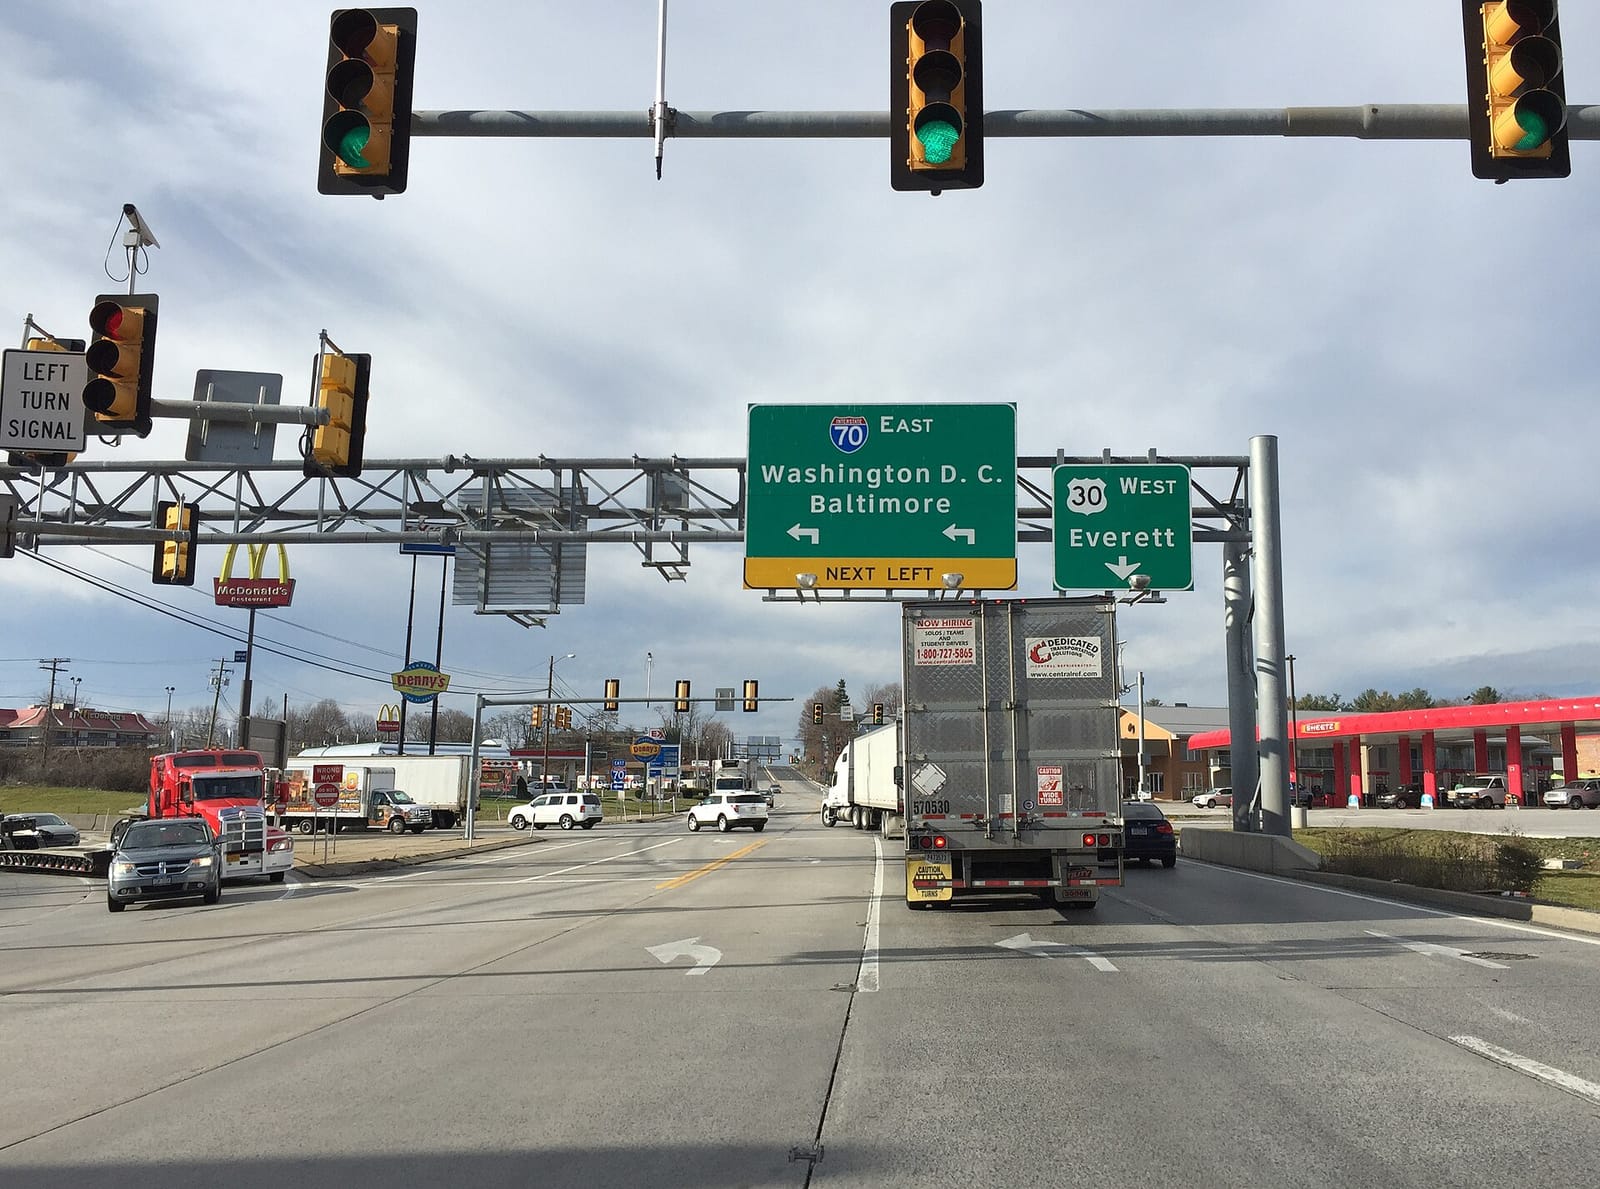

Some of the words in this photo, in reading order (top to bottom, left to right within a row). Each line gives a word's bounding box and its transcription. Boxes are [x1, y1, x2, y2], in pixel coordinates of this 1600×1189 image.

[24, 363, 69, 382] LEFT
[21, 391, 69, 411] TURN
[8, 419, 76, 440] SIGNAL
[834, 425, 863, 446] 70
[761, 463, 930, 488] Washington
[941, 465, 966, 483] D.
[978, 465, 1002, 483] C.
[810, 493, 951, 513] Baltimore
[1071, 486, 1102, 506] 30
[1070, 528, 1175, 547] Everett
[826, 567, 875, 581] NEXT
[887, 567, 933, 581] LEFT
[217, 586, 288, 596] McDonald's
[1047, 638, 1099, 653] DEDICATED
[1050, 646, 1095, 658] TRANSPORTATION
[917, 648, 973, 659] 1-800-727-5865
[397, 674, 446, 688] Denny's
[1306, 723, 1334, 732] SHEETZ
[633, 744, 658, 753] Denny's
[613, 770, 625, 779] 70
[913, 801, 950, 814] 570530
